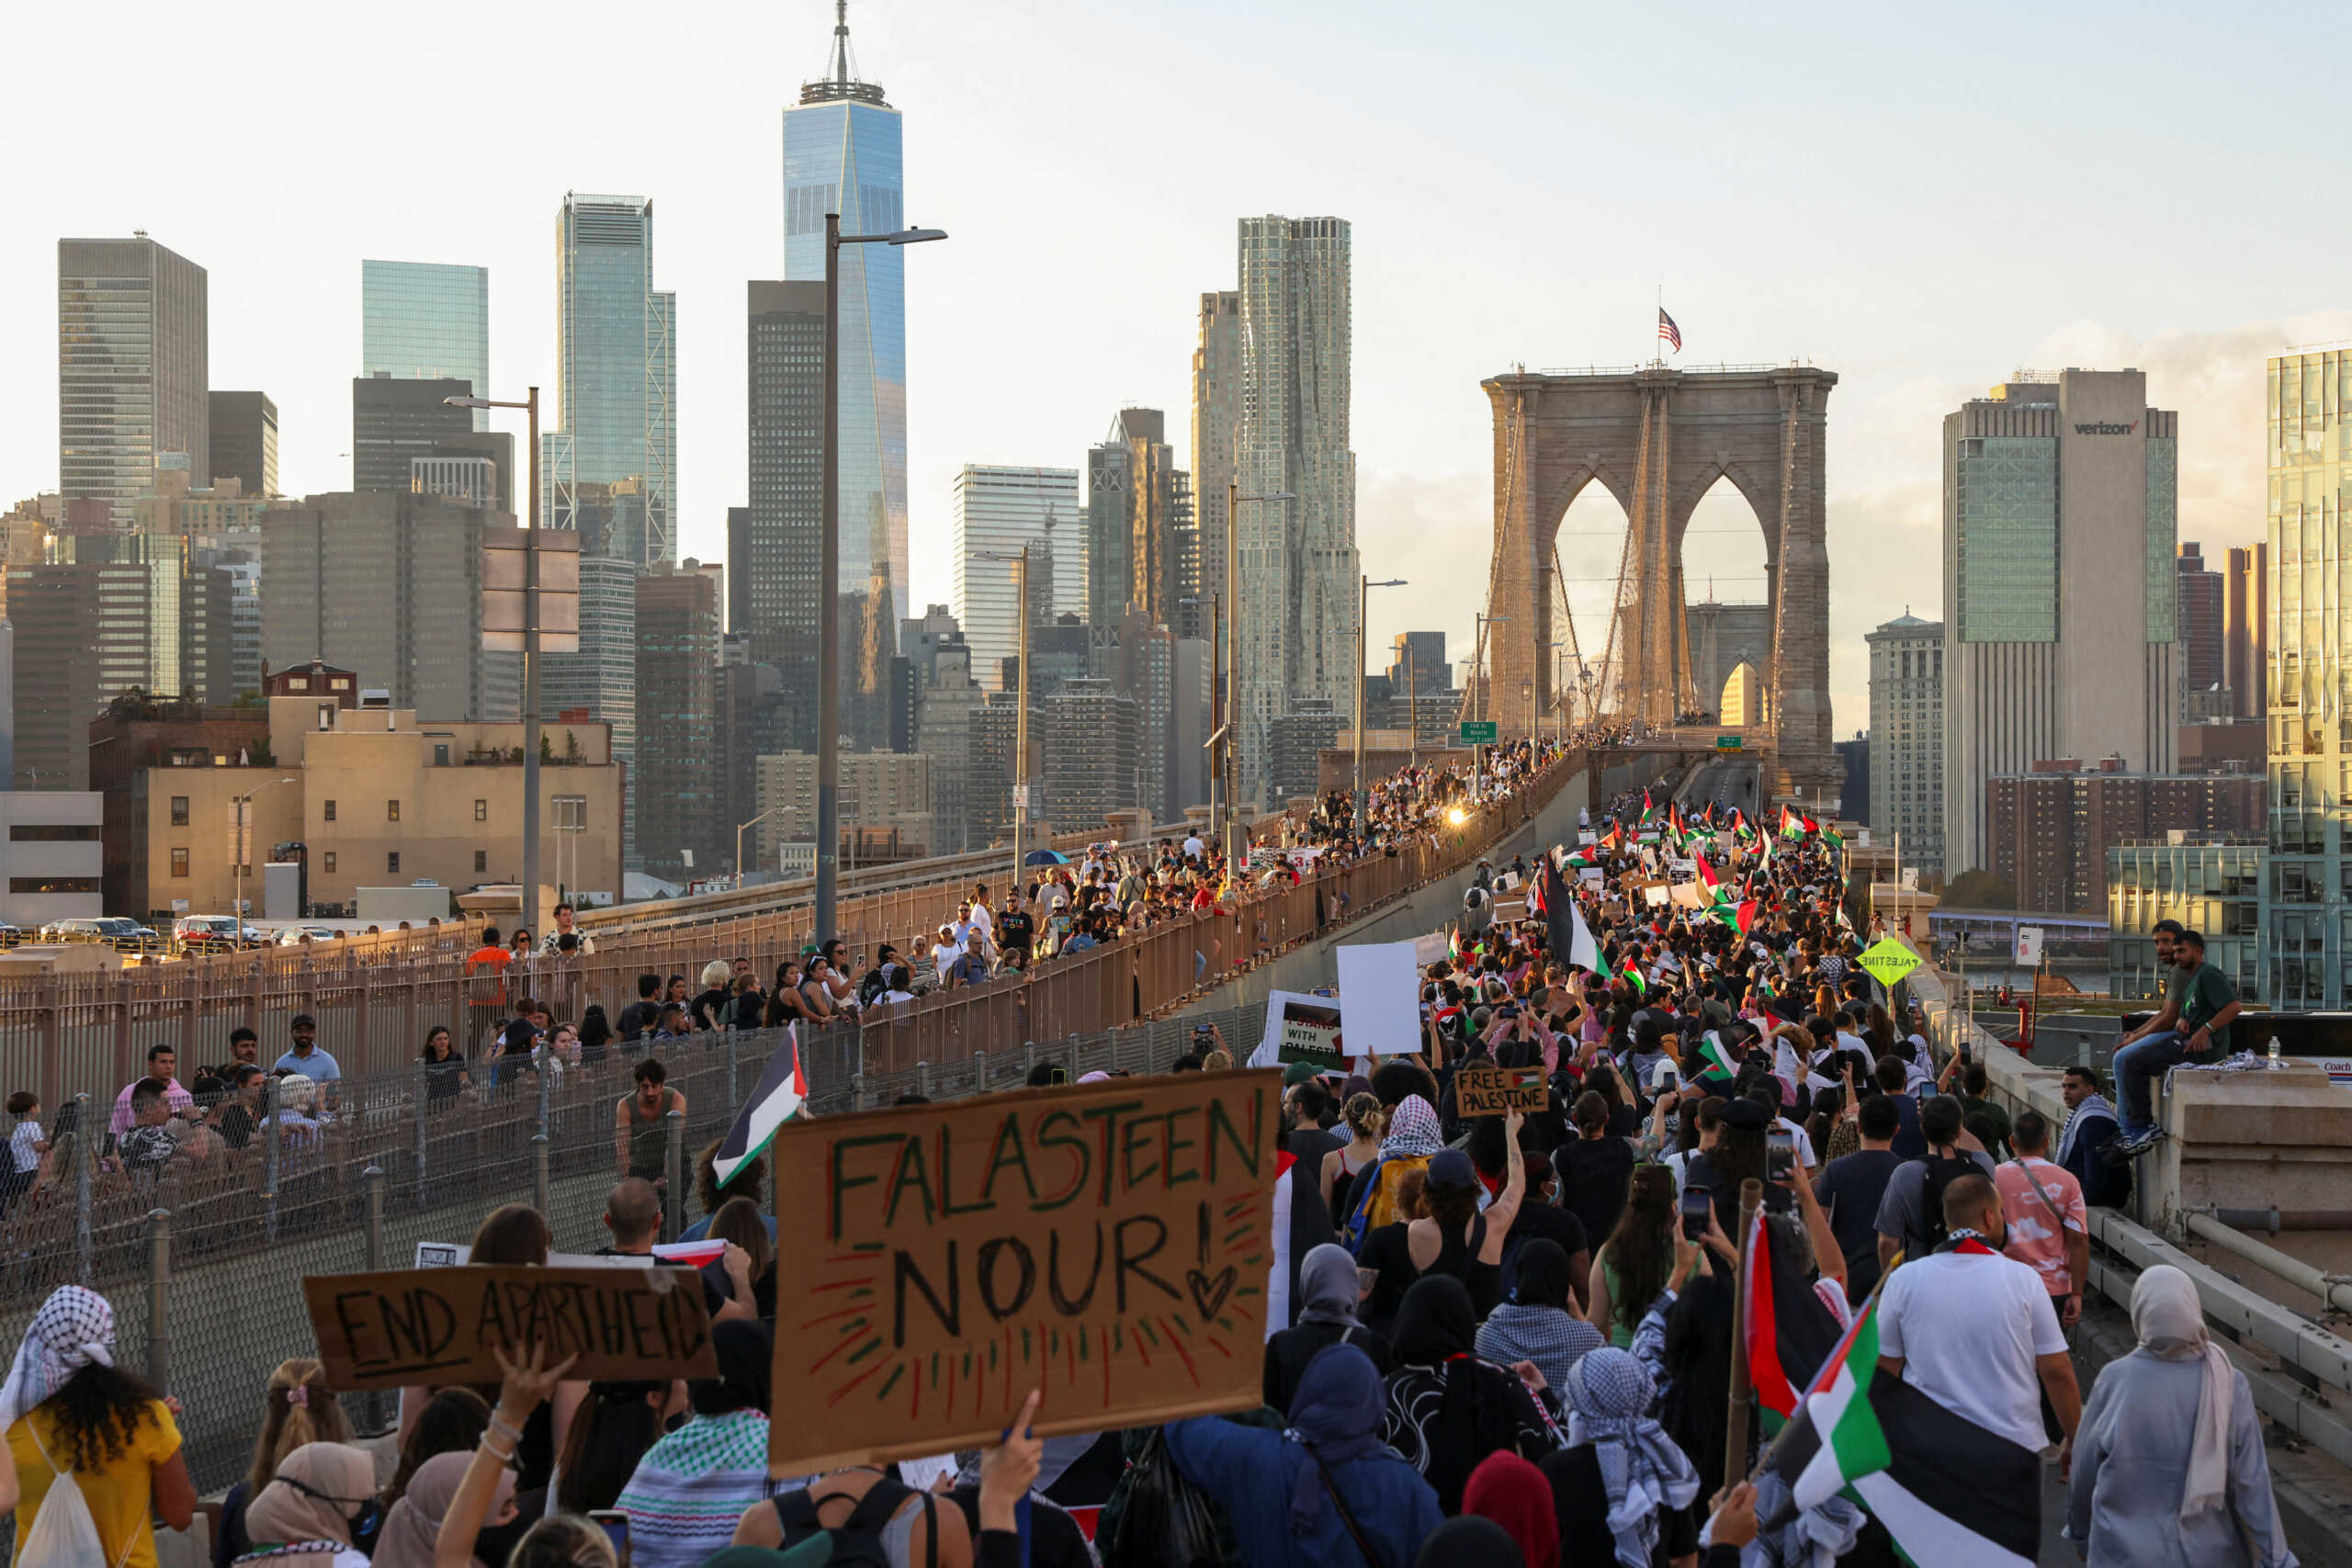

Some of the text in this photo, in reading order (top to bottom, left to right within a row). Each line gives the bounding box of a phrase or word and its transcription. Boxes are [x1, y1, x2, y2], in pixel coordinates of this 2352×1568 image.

[2074, 421, 2132, 435] verizon
[1296, 1017, 1336, 1031] STAND
[1287, 1029, 1317, 1043] WITH
[2324, 1062, 2351, 1072] Coach
[1459, 1071, 1506, 1089] FREE
[1463, 1088, 1544, 1111] PALESTINE
[828, 1088, 1264, 1245] FALASTEEN
[335, 1279, 706, 1367] END APARTHEID
